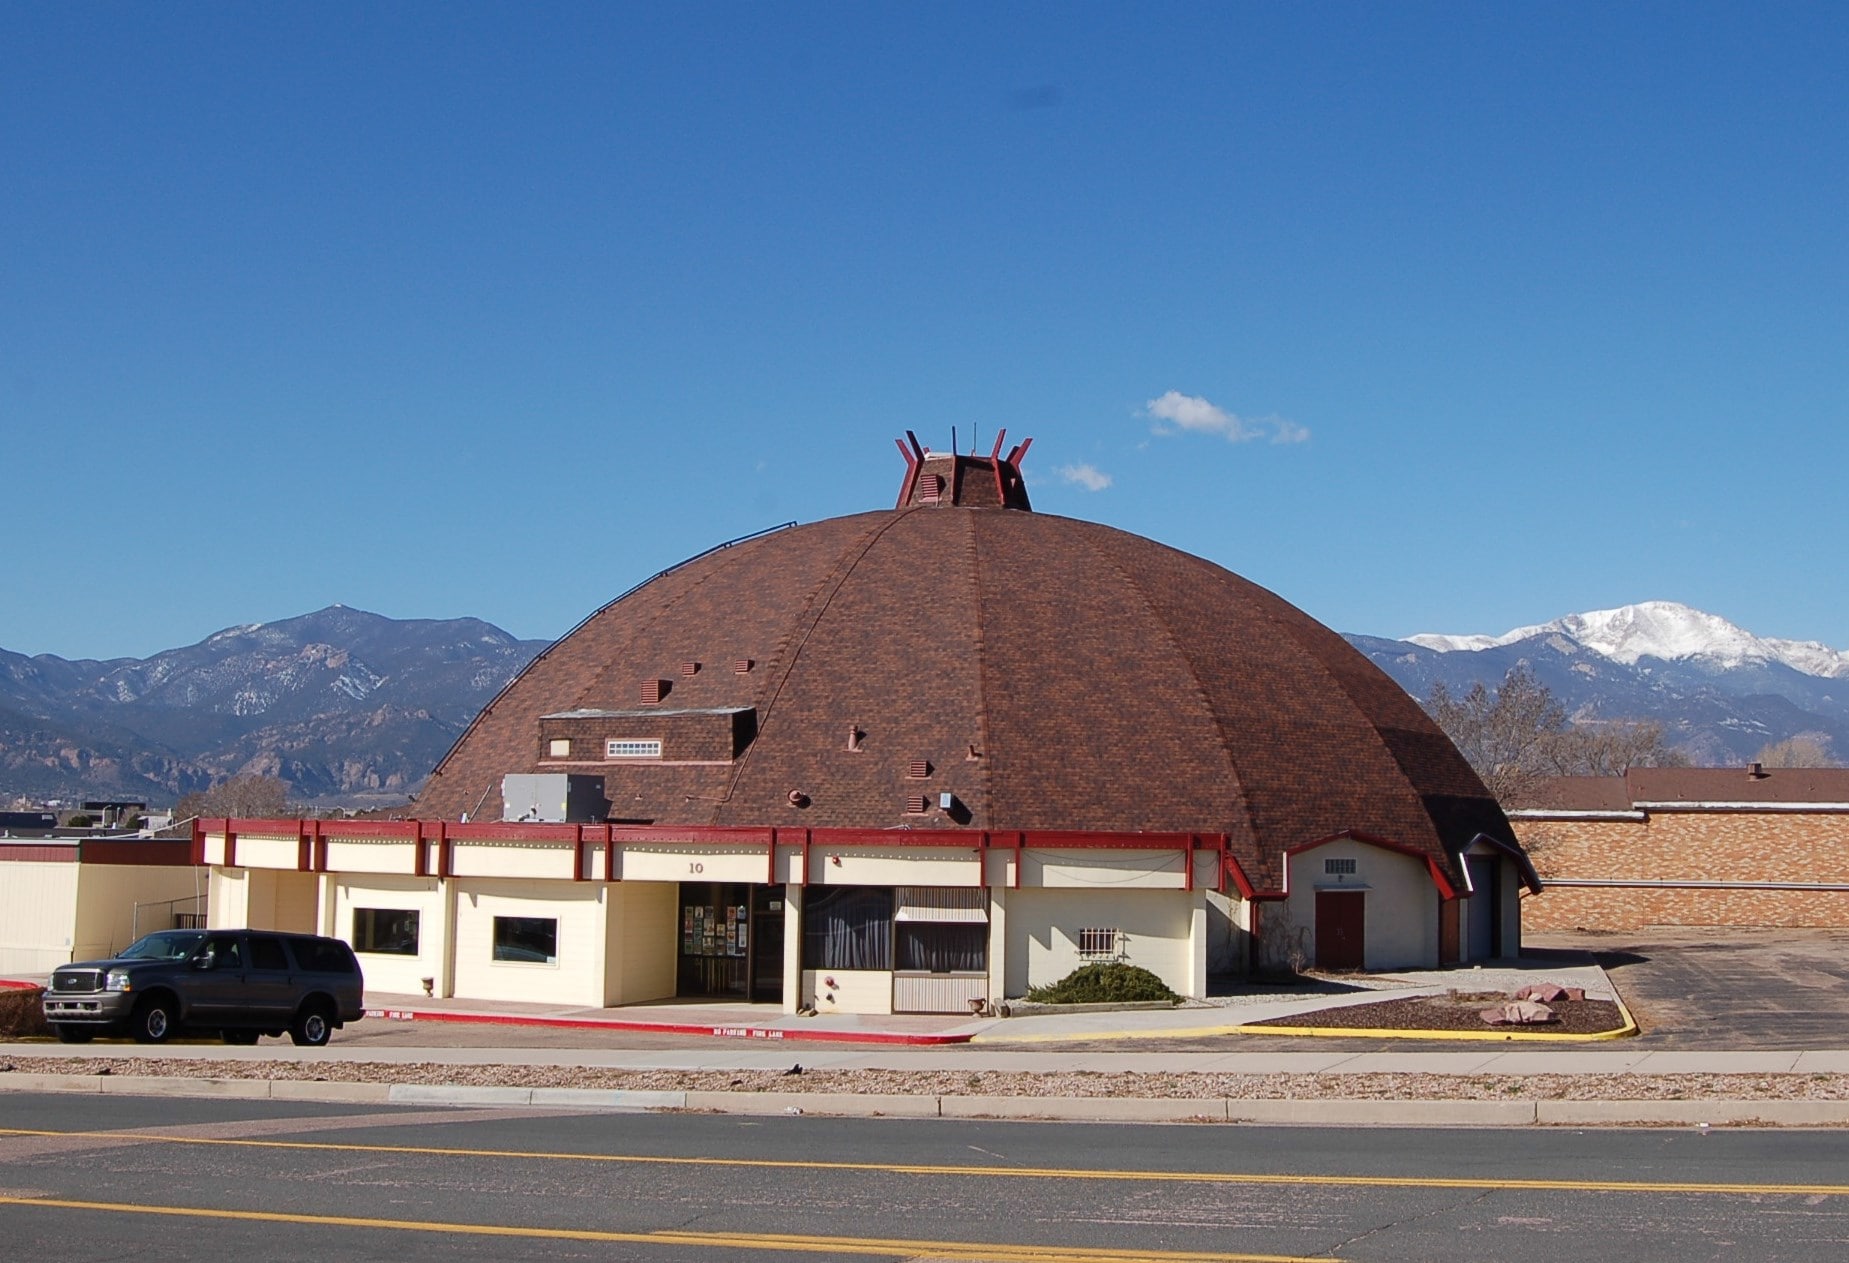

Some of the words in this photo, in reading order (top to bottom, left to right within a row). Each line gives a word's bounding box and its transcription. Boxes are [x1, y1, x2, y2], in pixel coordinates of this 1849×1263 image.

[689, 862, 704, 874] 10
[722, 1028, 746, 1036] PARKING
[753, 1030, 766, 1038] FIRE
